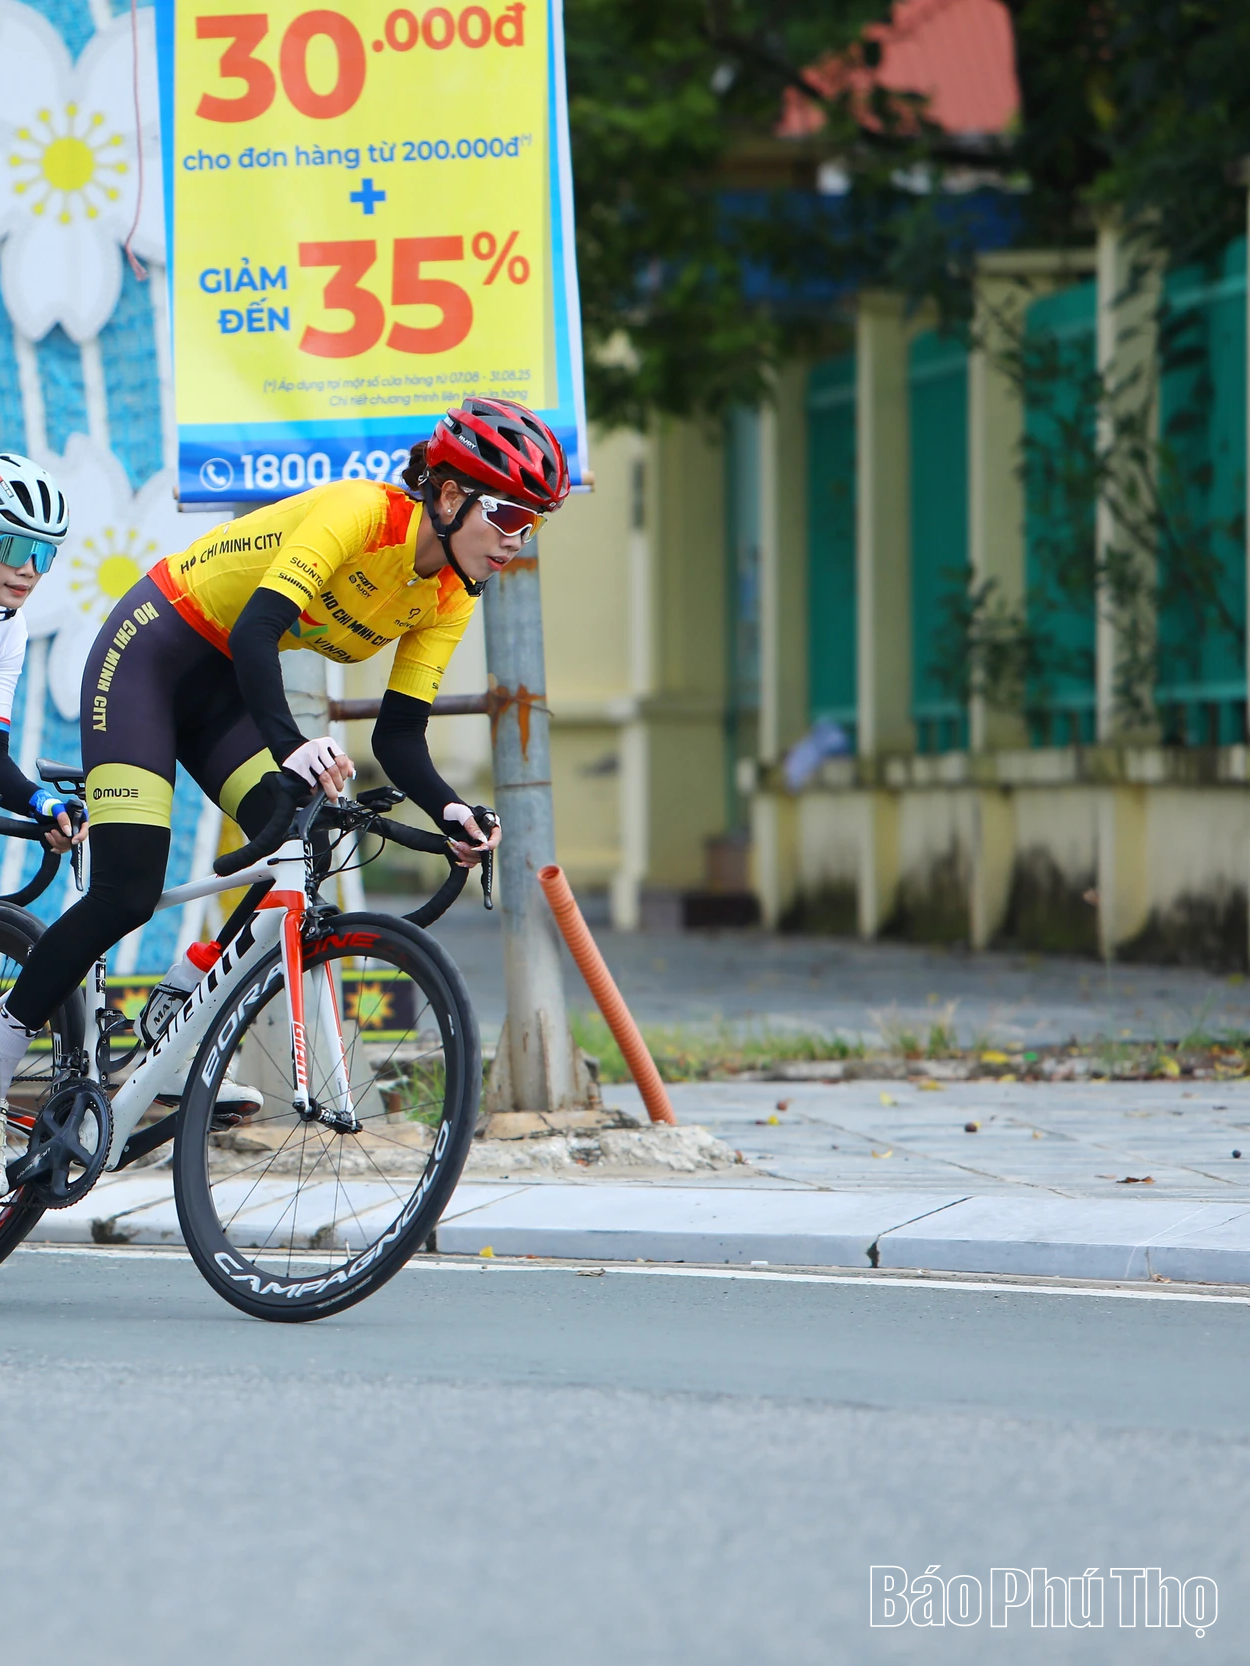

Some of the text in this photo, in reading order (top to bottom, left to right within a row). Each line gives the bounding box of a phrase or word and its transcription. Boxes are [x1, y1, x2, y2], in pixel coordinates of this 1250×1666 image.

[183, 151, 230, 171] cho
[238, 147, 287, 169] đơn
[295, 145, 360, 169] hàng
[368, 140, 396, 163] từ
[199, 257, 288, 294] GIẢM
[218, 298, 291, 334] ĐẾN
[240, 448, 412, 489] 1800 692
[200, 543, 218, 563] CHI
[219, 537, 251, 554] MINH
[254, 531, 283, 551] CITY
[289, 556, 324, 587] SUUNTO
[320, 590, 339, 611] HO
[332, 608, 352, 626] CHI
[92, 600, 161, 732] HO CHI MINH CITY
[201, 961, 285, 1089] BORA
[213, 1119, 452, 1299] CAMPAGNOLO
